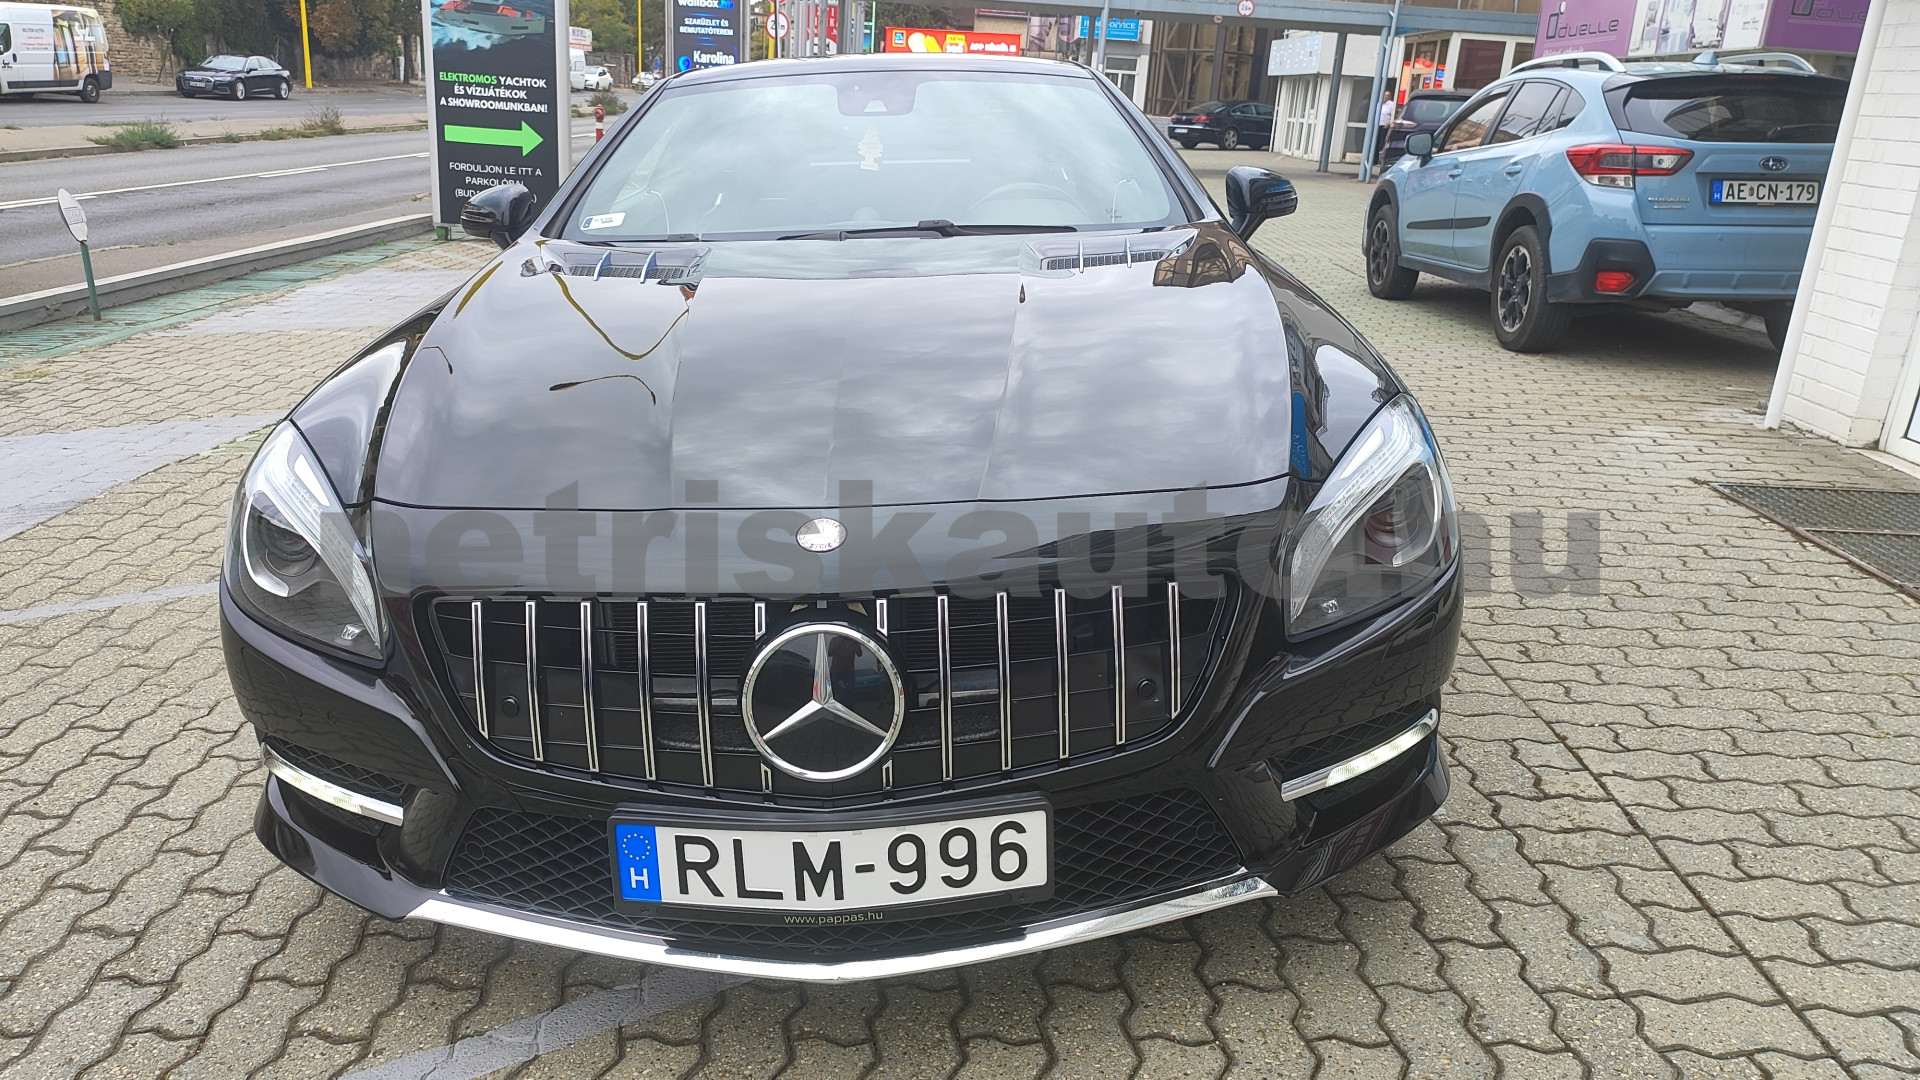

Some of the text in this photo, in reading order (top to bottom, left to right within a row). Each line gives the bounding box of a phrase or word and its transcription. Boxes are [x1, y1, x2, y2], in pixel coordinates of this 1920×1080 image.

[684, 17, 729, 27] SZAKÜZLET ÉS
[679, 26, 734, 36] BEMUTATÓTEREM
[693, 50, 735, 65] Karolina
[439, 72, 547, 88] ELEKTROMOS YACHTOK
[454, 83, 528, 100] ÉS VÍZIJÁTÉKOK
[440, 96, 548, 113] A SHOWROOMUNKBAN!
[449, 162, 542, 176] FORDULJON LE ITT A
[1714, 192, 1720, 200] H
[674, 820, 1029, 902] RLM-996
[630, 867, 649, 890] H
[783, 911, 884, 925] www.pappas.hu
